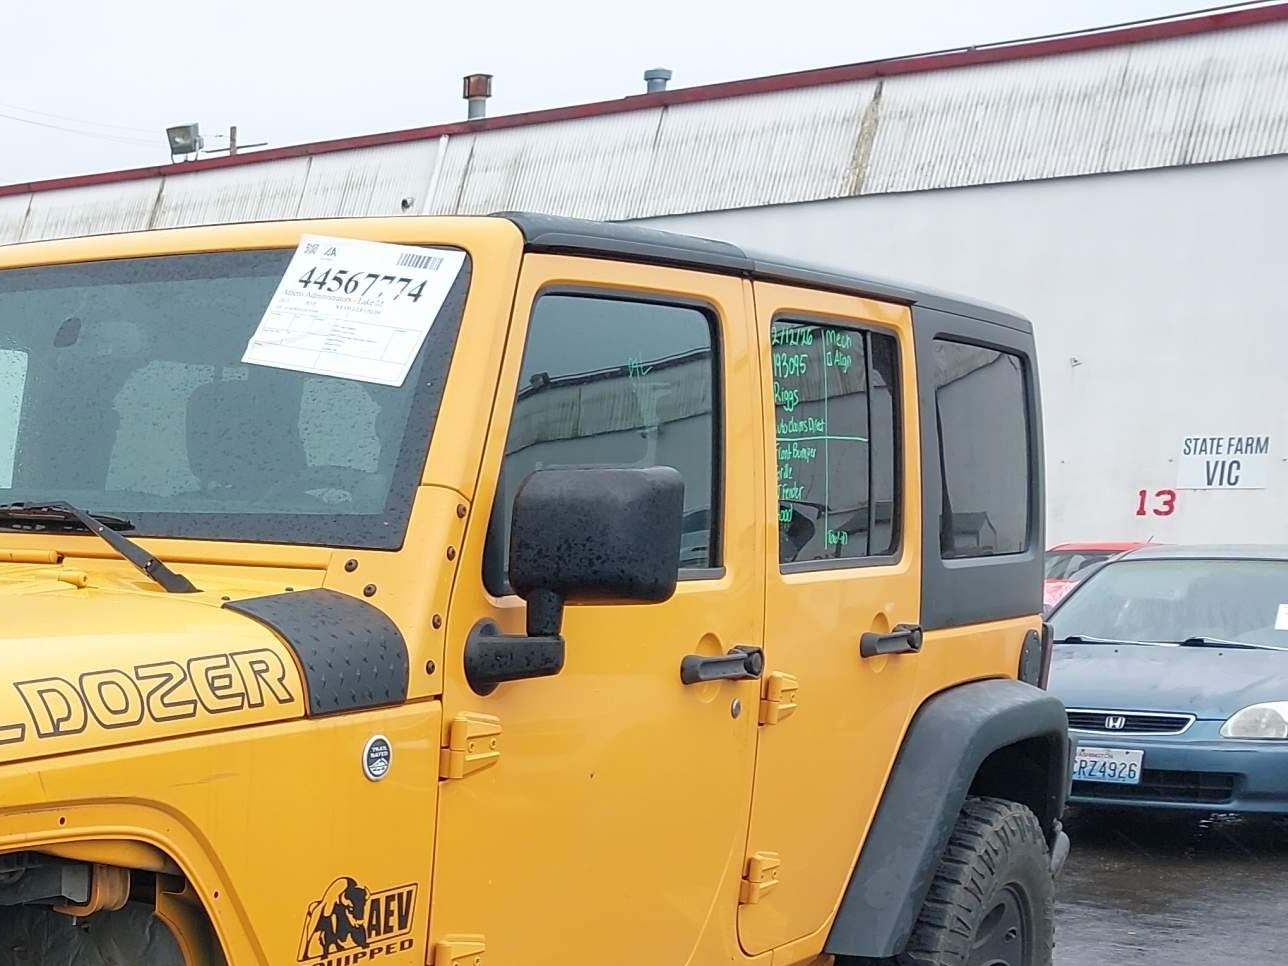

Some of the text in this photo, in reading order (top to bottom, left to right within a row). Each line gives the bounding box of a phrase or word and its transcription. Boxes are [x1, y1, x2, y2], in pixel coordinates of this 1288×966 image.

[298, 266, 429, 303] 44567774
[1183, 436, 1269, 455] STATE FARM
[1205, 459, 1241, 487] VIC
[1136, 489, 1177, 518] 13
[13, 647, 295, 738] DOZER
[366, 888, 414, 939] AEV
